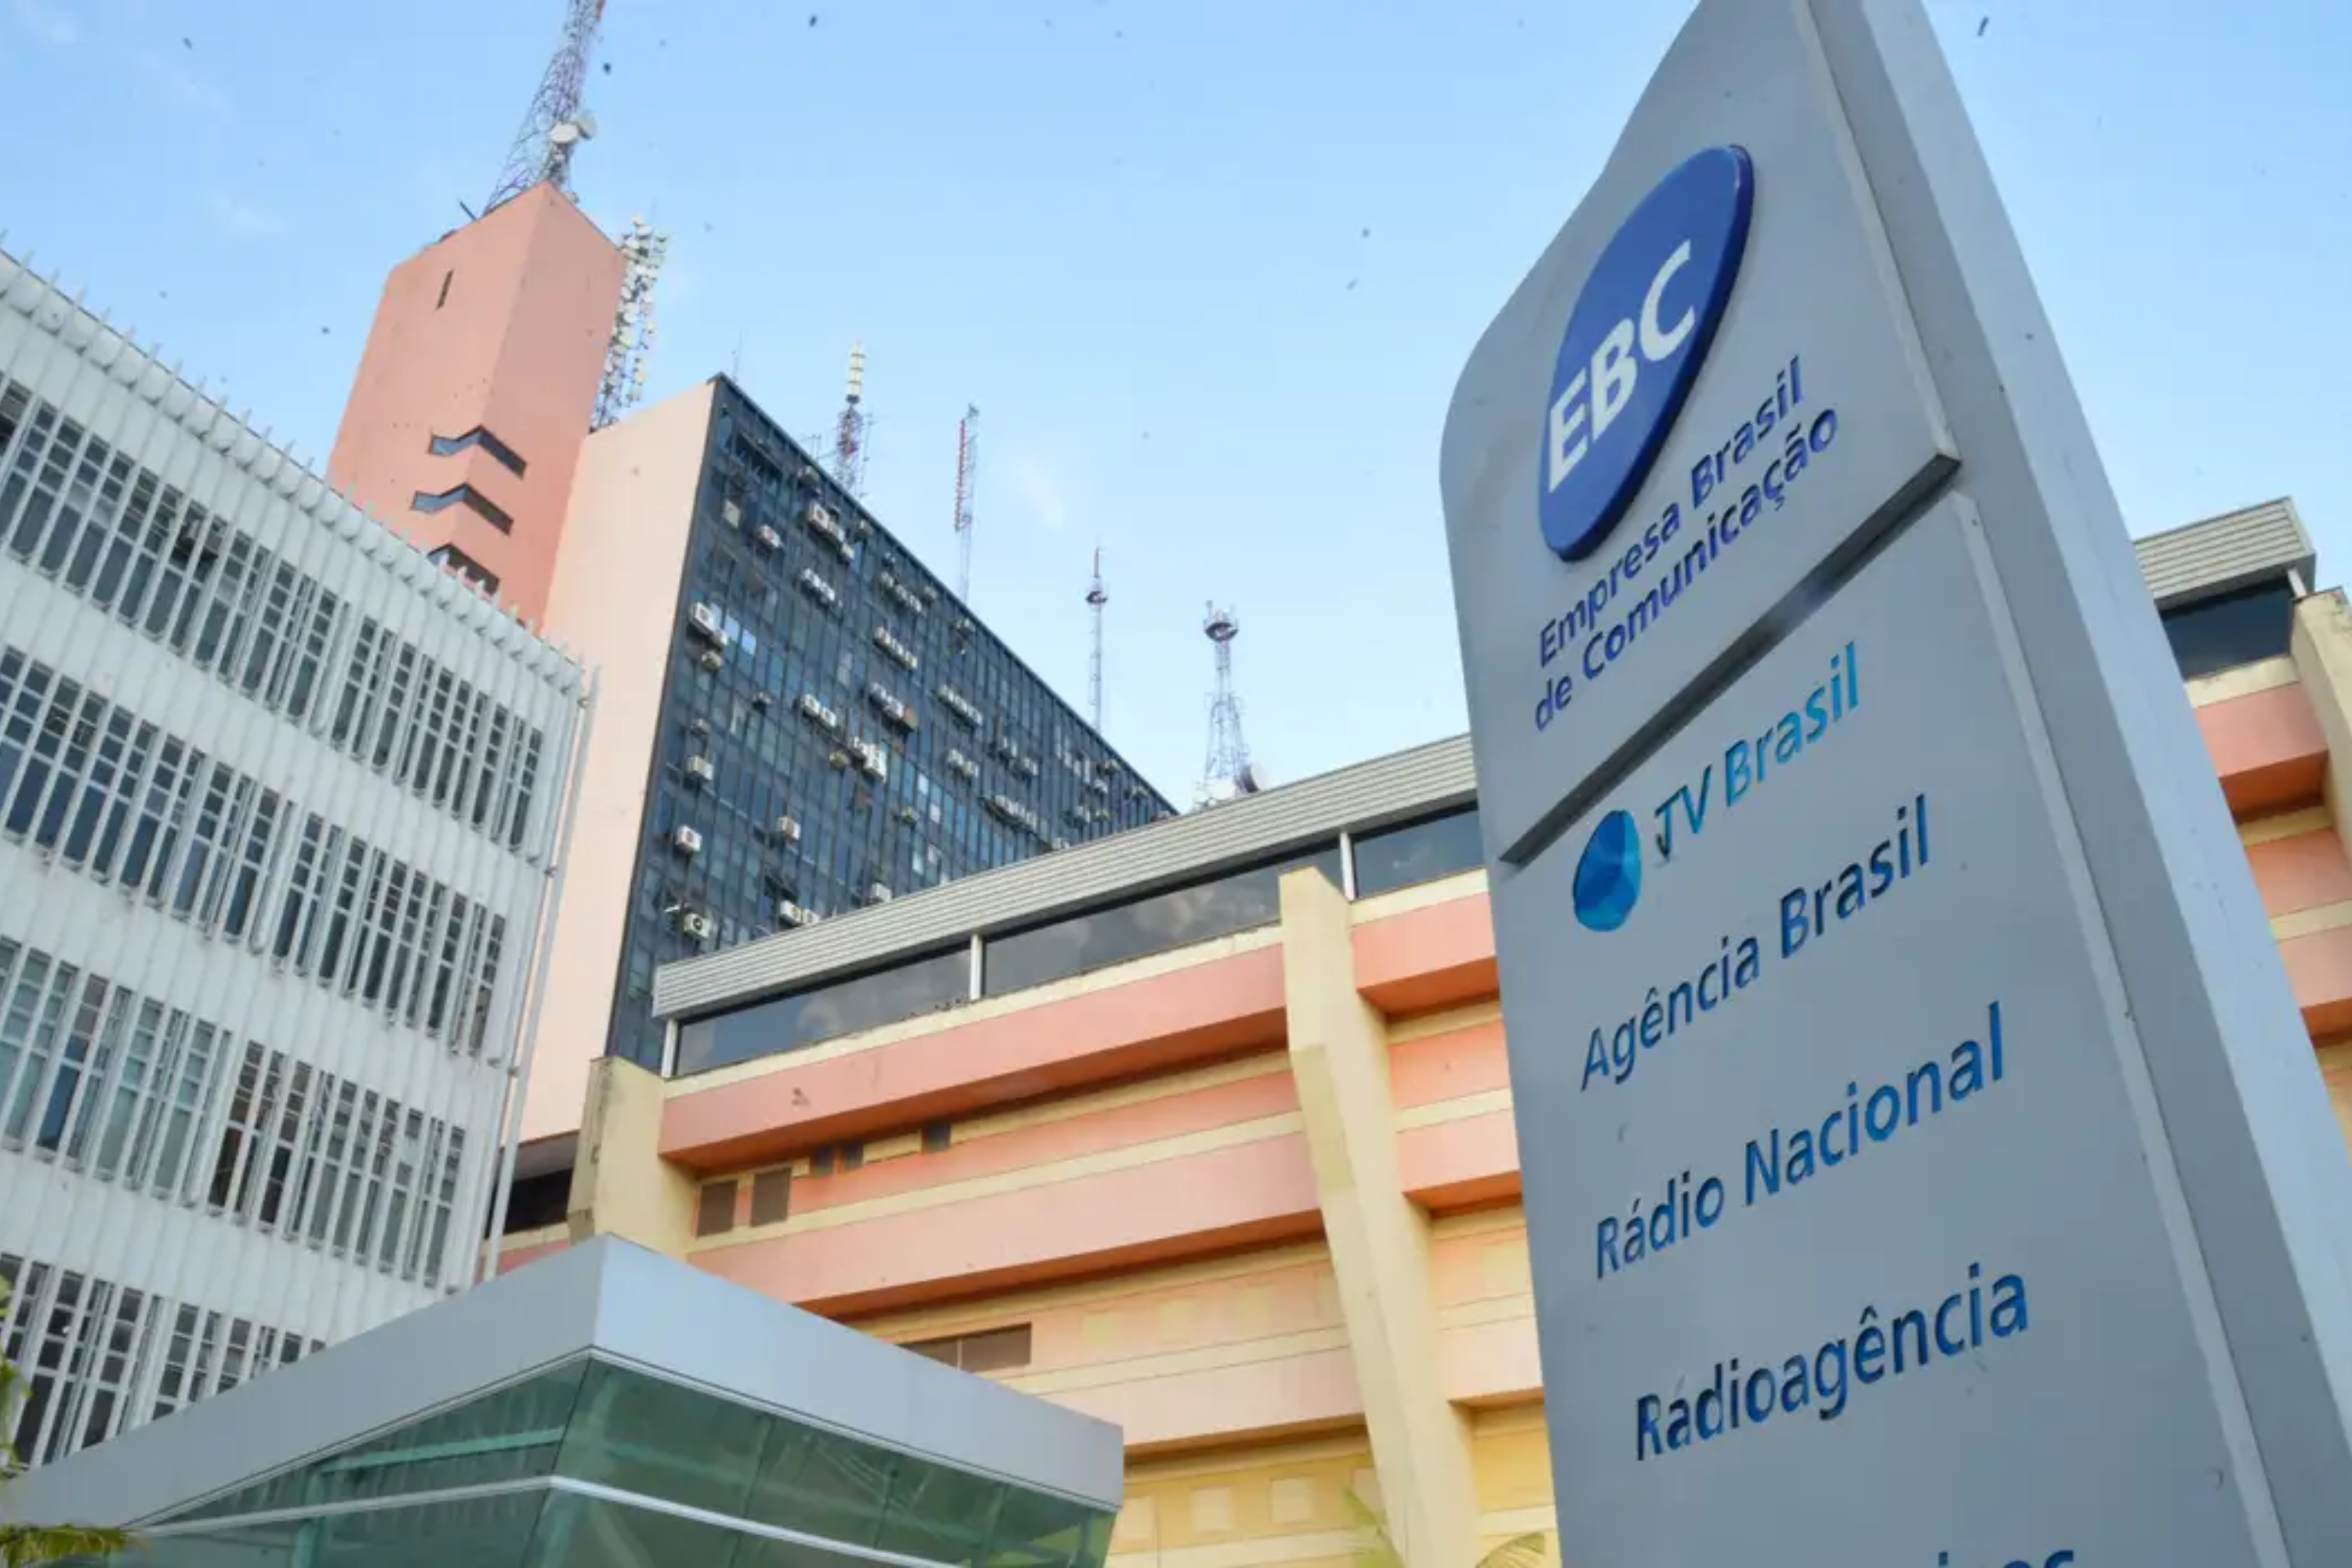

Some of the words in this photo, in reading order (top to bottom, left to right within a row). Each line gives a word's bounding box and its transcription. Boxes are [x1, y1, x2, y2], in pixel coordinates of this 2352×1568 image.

[1548, 238, 1695, 494] EBC
[1534, 674, 1573, 732] de
[1581, 408, 1839, 681] Comunicação
[1539, 502, 1681, 668] Empresa
[1691, 354, 1804, 511] Brasil
[1724, 641, 1860, 808] Brasil
[1581, 935, 1762, 1092] Agência
[1779, 793, 1929, 960] Brasil
[1595, 1171, 1726, 1280] Rádio
[1742, 1000, 2004, 1207] Nacional
